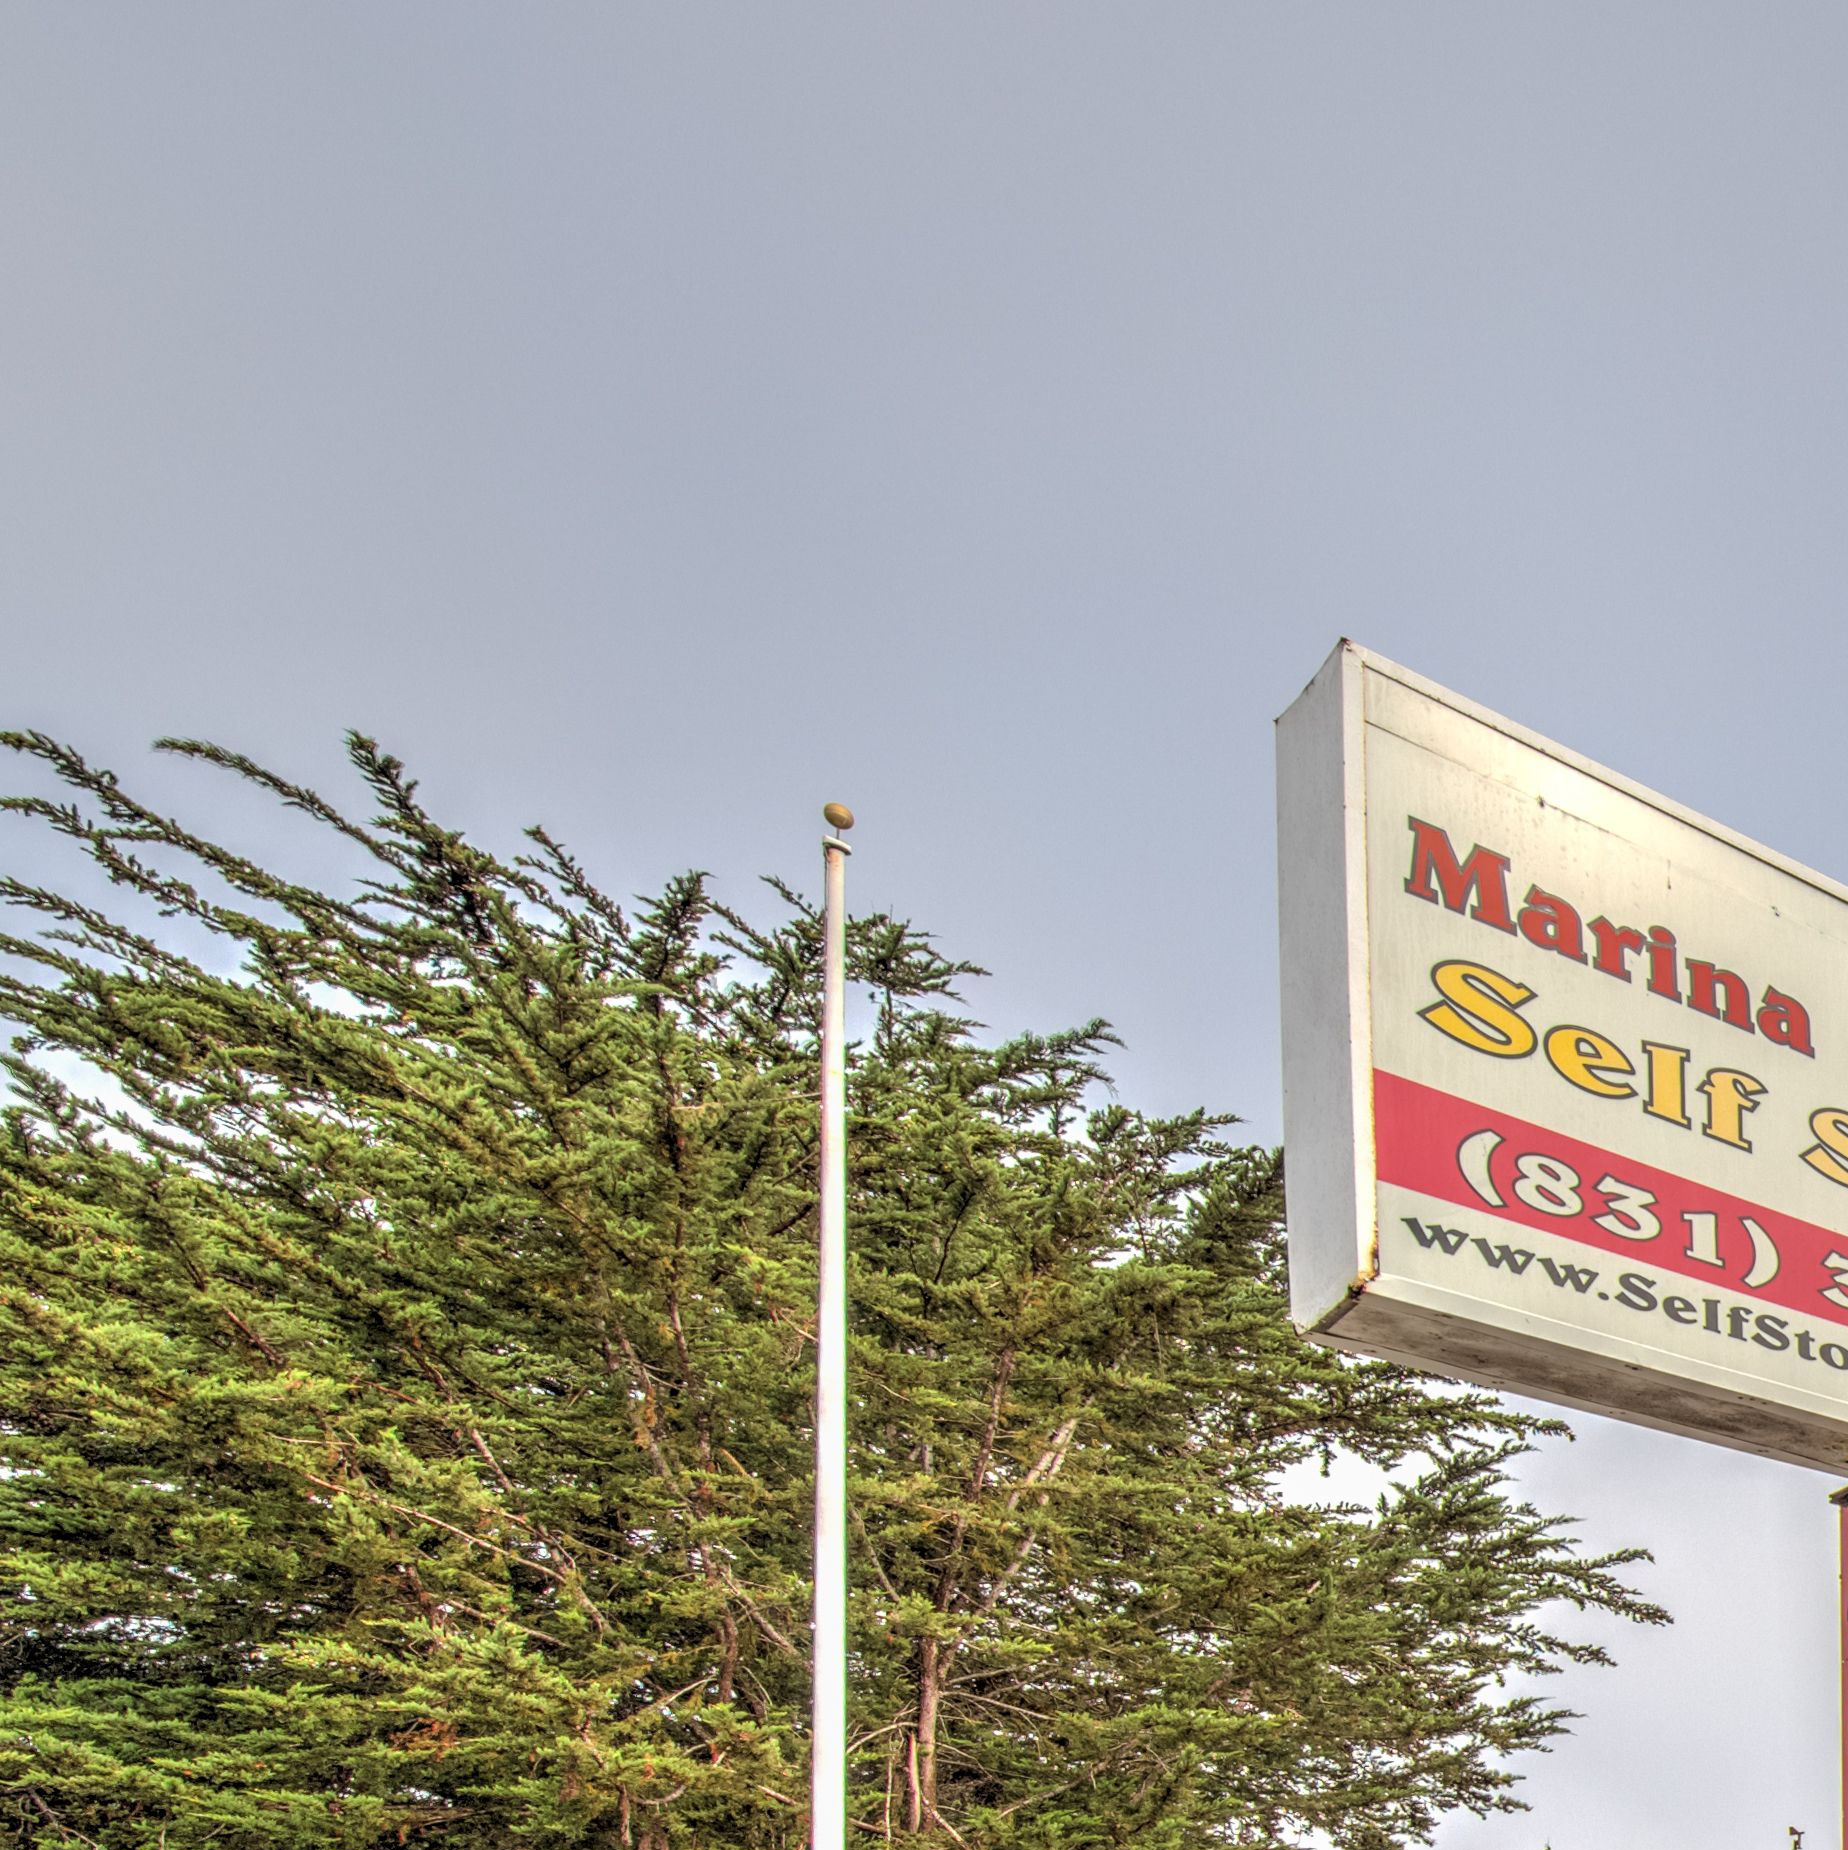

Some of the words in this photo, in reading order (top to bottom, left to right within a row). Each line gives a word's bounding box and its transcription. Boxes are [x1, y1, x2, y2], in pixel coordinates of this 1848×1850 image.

[1405, 815, 1815, 1058] Marina
[1417, 959, 1770, 1152] Self
[1457, 1129, 1779, 1288] (831)
